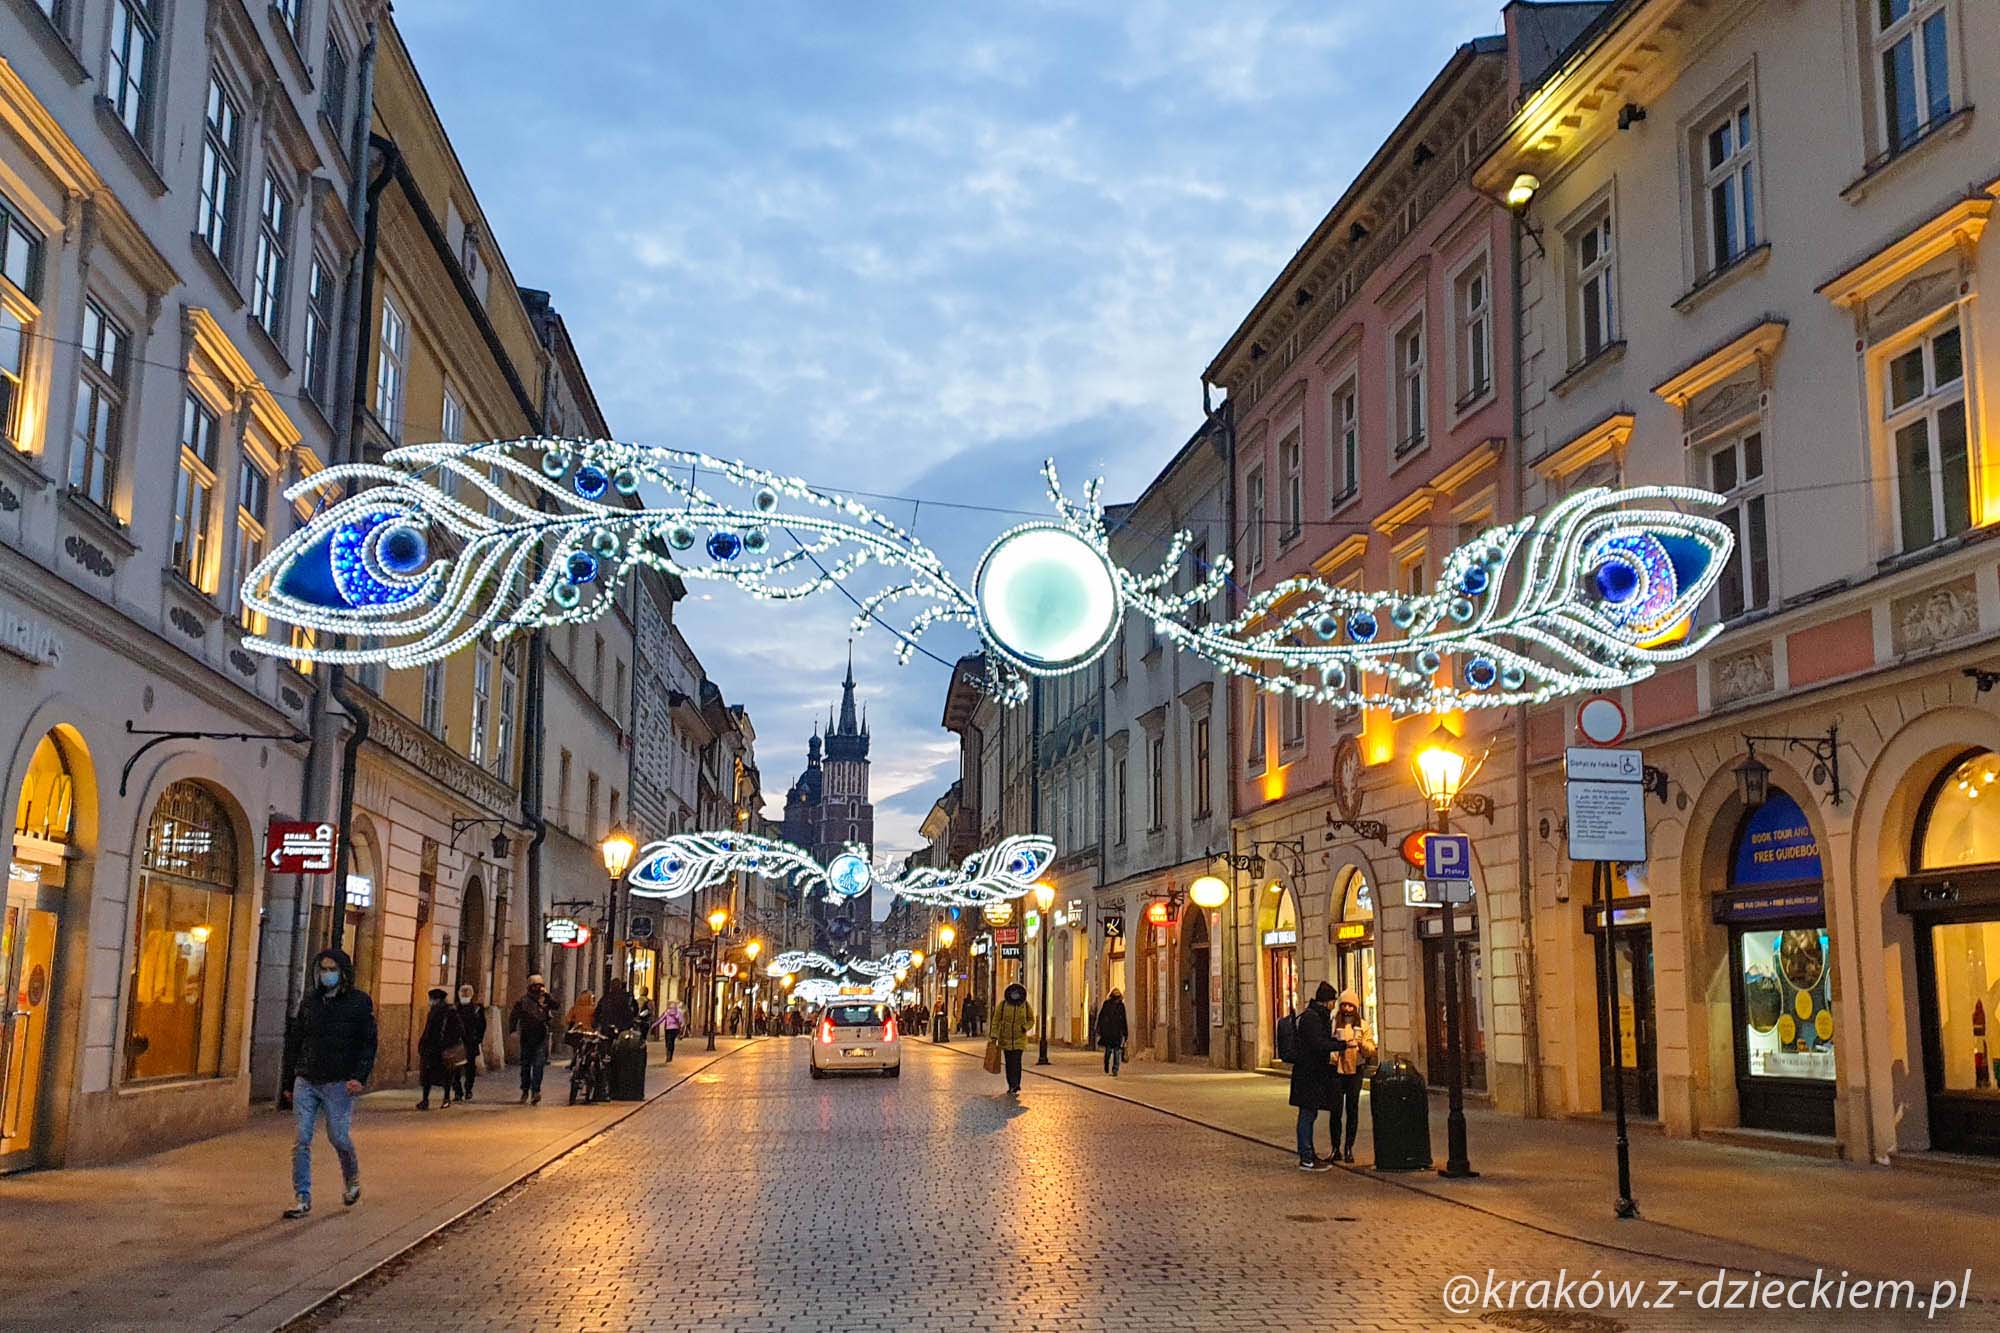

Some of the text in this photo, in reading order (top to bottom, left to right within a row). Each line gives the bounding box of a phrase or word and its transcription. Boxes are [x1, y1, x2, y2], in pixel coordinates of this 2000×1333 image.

[1751, 832, 1771, 844] BOOK
[1773, 829, 1793, 840] TOUR
[283, 846, 330, 855] Apartments
[1754, 844, 1819, 863] FREE GUIDEBOO
[1434, 839, 1460, 875] P
[303, 860, 329, 869] Hostel
[1002, 947, 1020, 956] TATT
